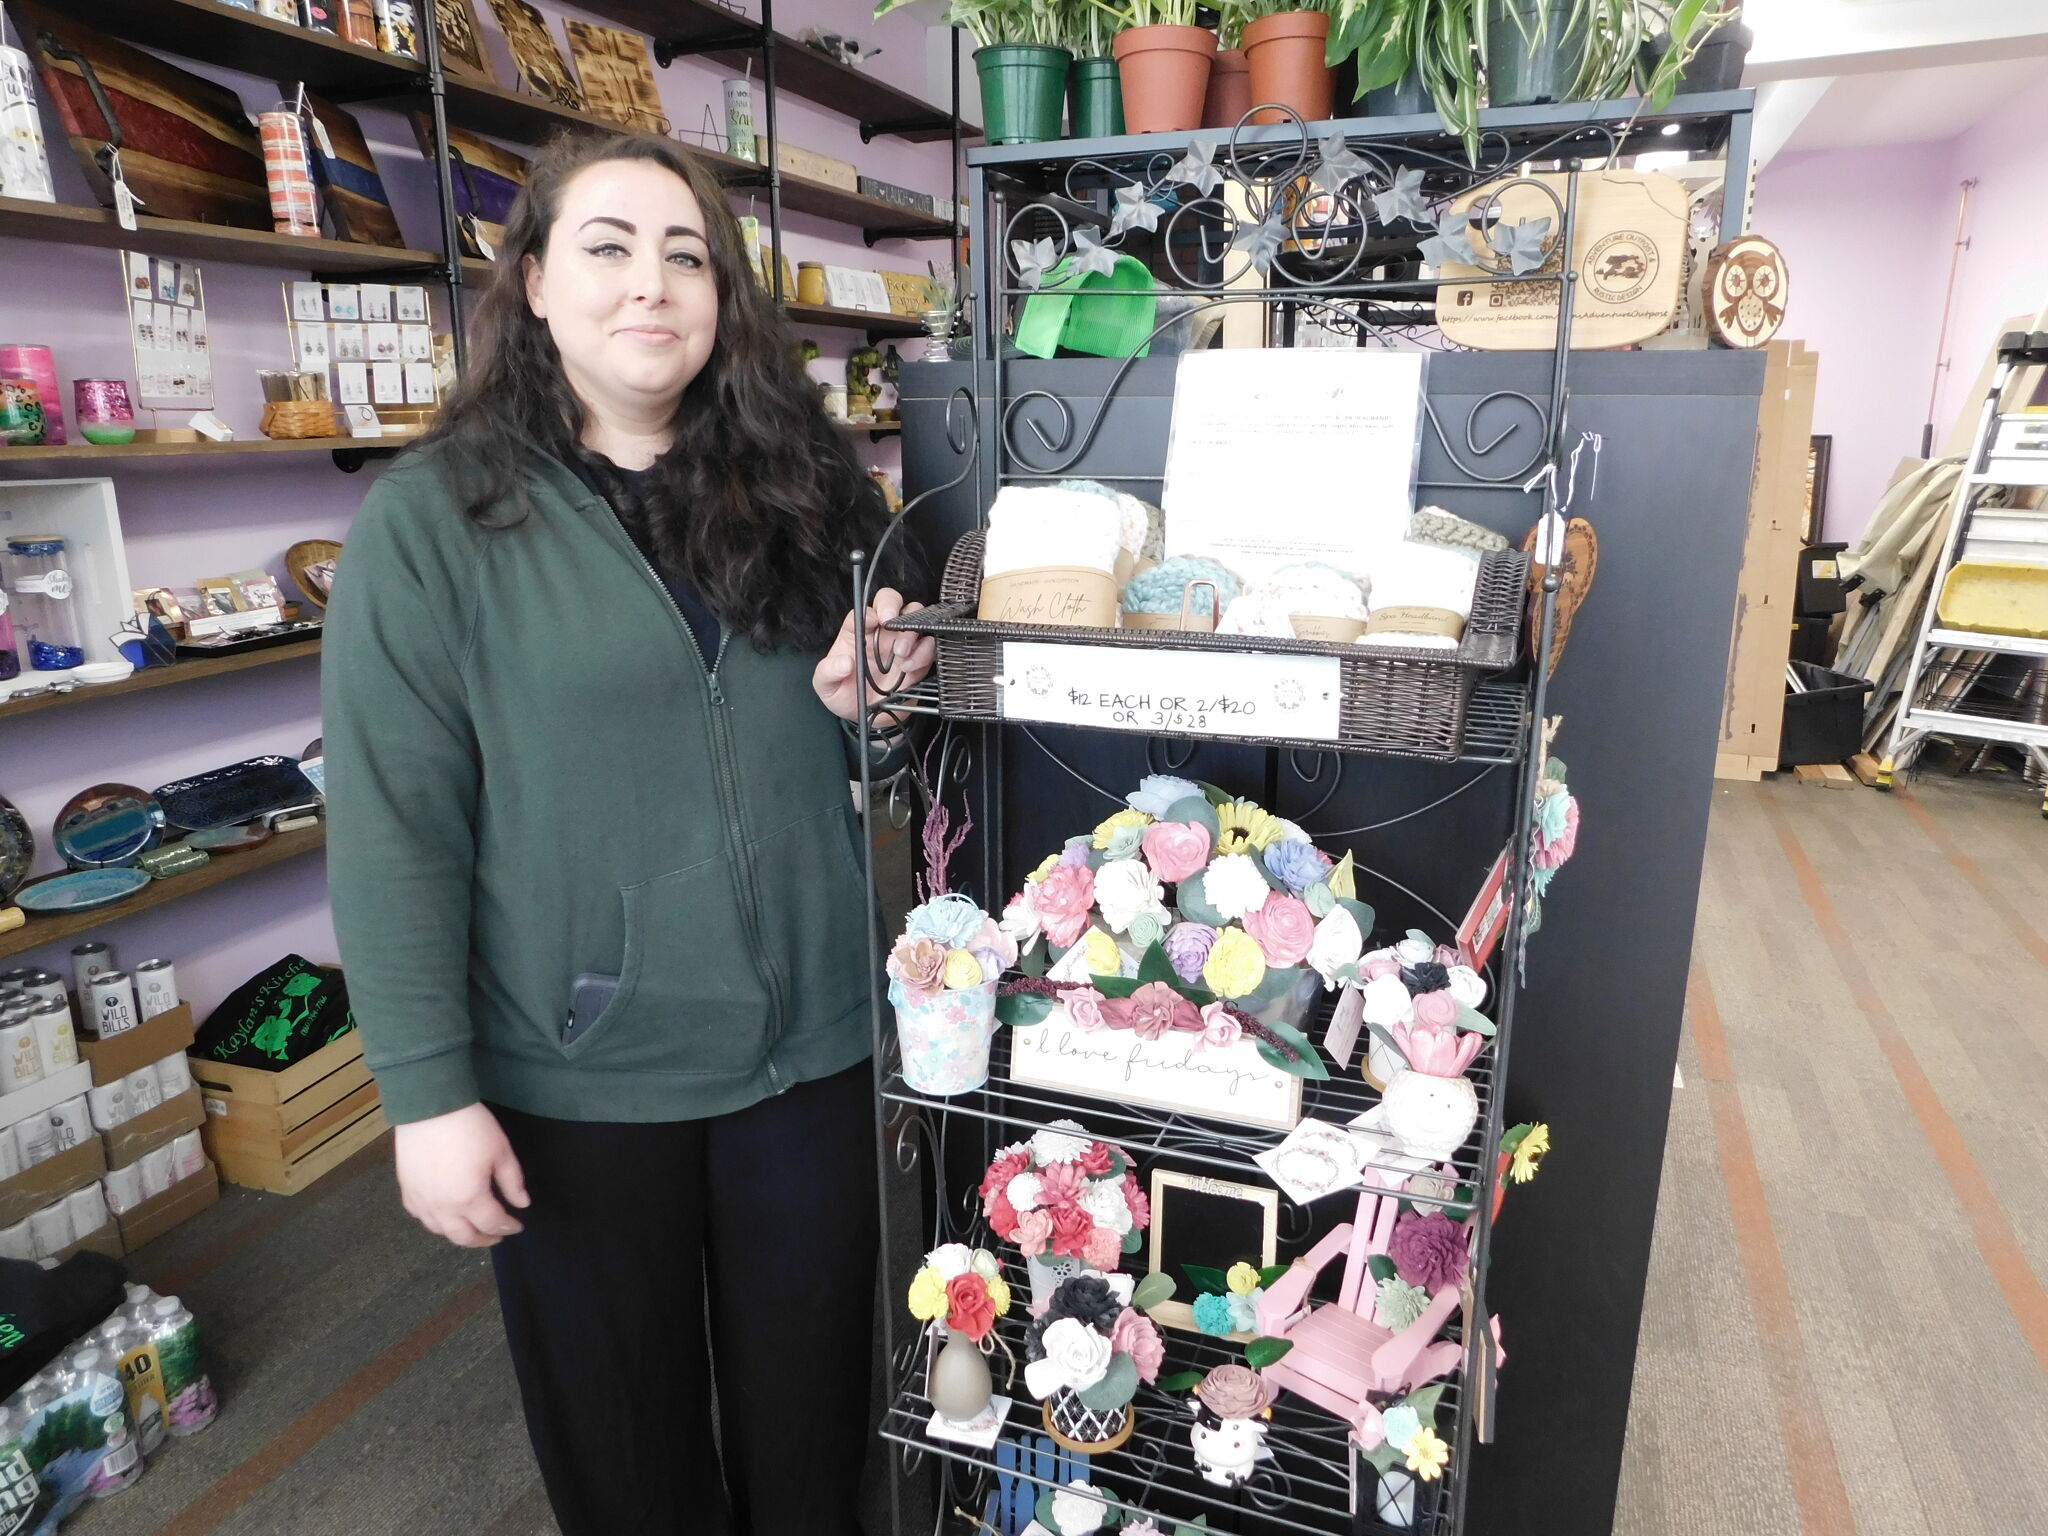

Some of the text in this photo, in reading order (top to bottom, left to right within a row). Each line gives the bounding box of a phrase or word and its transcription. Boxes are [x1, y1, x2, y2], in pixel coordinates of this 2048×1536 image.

[1587, 233, 1625, 265] ADVENTURE
[1625, 233, 1655, 256] OUTPOST
[1593, 285, 1643, 302] RUSTIC DESIGN
[998, 591, 1093, 622] Wash Cloth
[1378, 611, 1449, 622] Spa Headband
[1067, 687, 1257, 716] $12 EACH OR 2/$20
[1112, 710, 1139, 726] OR
[100, 1005, 128, 1022] WILD
[144, 991, 172, 1007] WILD
[213, 958, 308, 1060] Kaylan's Kitche
[1057, 1031, 1119, 1062] love
[1124, 1042, 1270, 1096] fridays
[124, 1353, 152, 1382] 40
